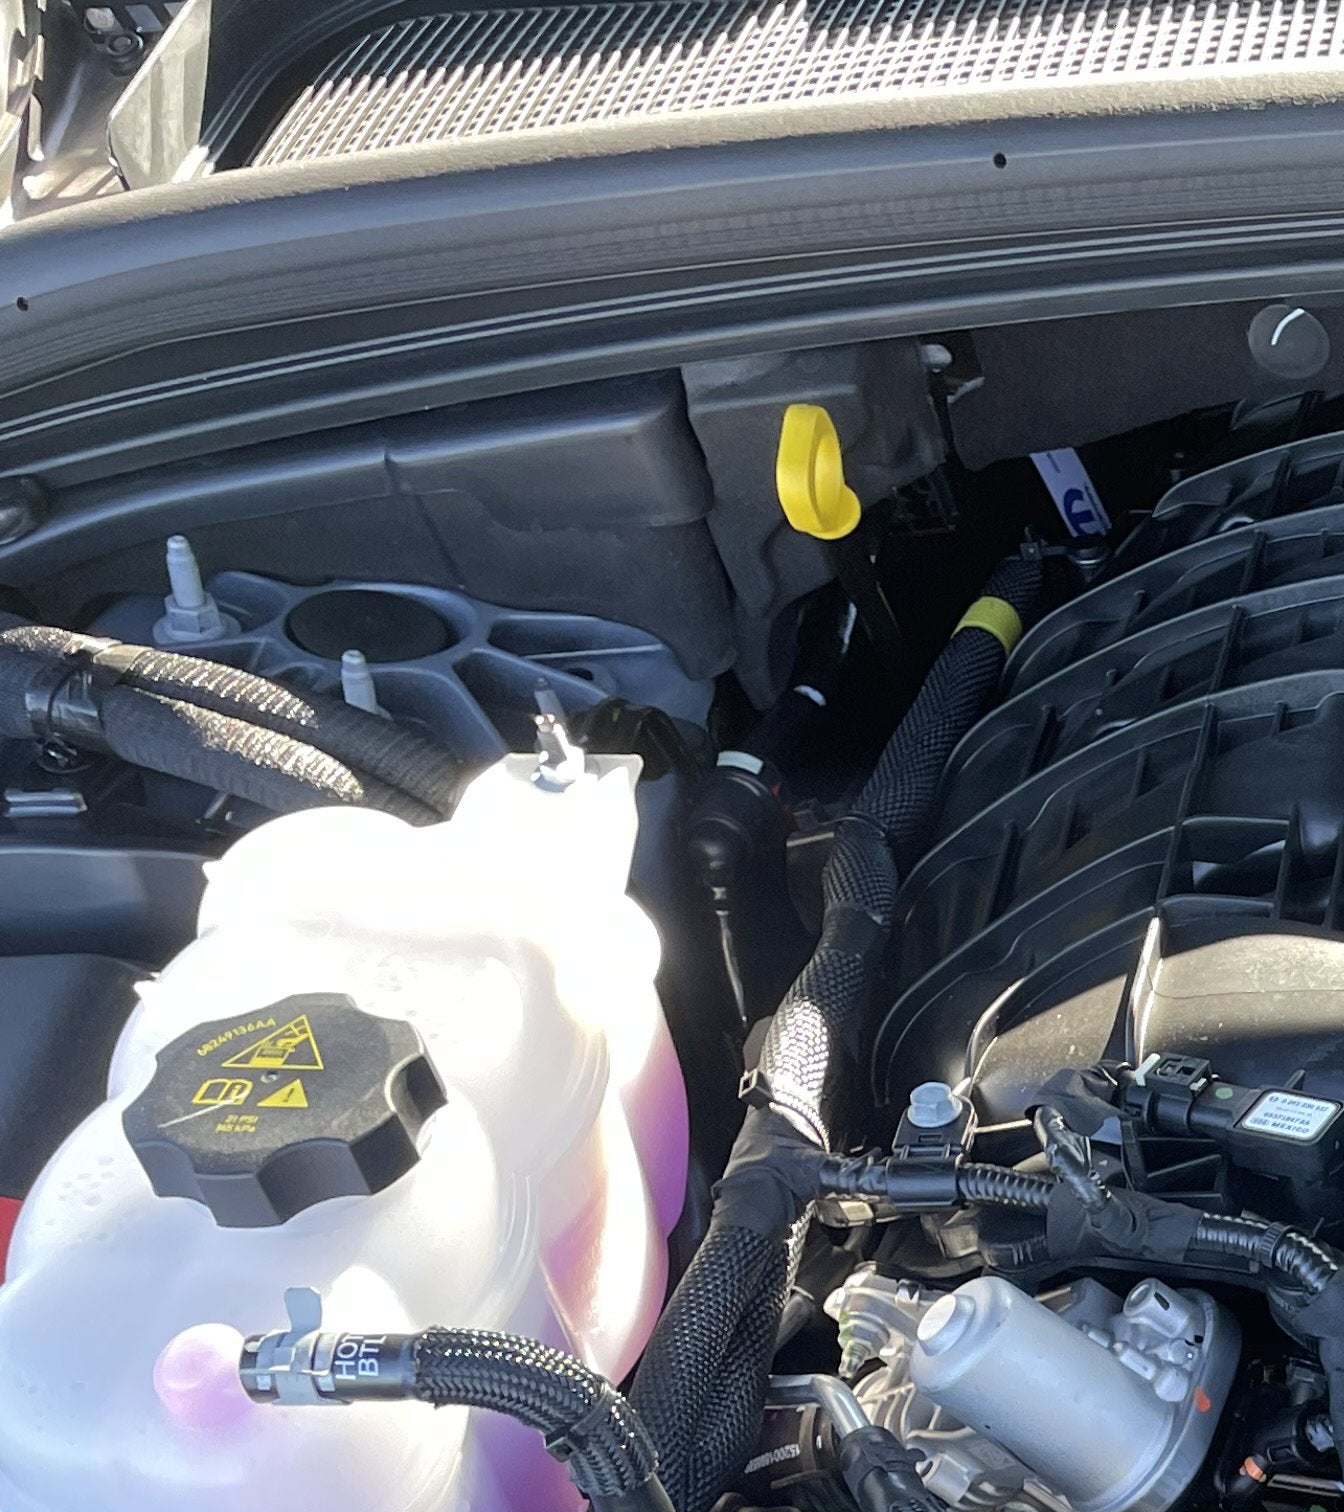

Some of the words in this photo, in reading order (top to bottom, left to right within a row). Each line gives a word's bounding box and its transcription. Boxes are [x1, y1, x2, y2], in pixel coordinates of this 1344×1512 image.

[239, 1114, 259, 1124] PSI
[334, 1335, 364, 1380] HOT
[358, 1335, 388, 1378] BTL
